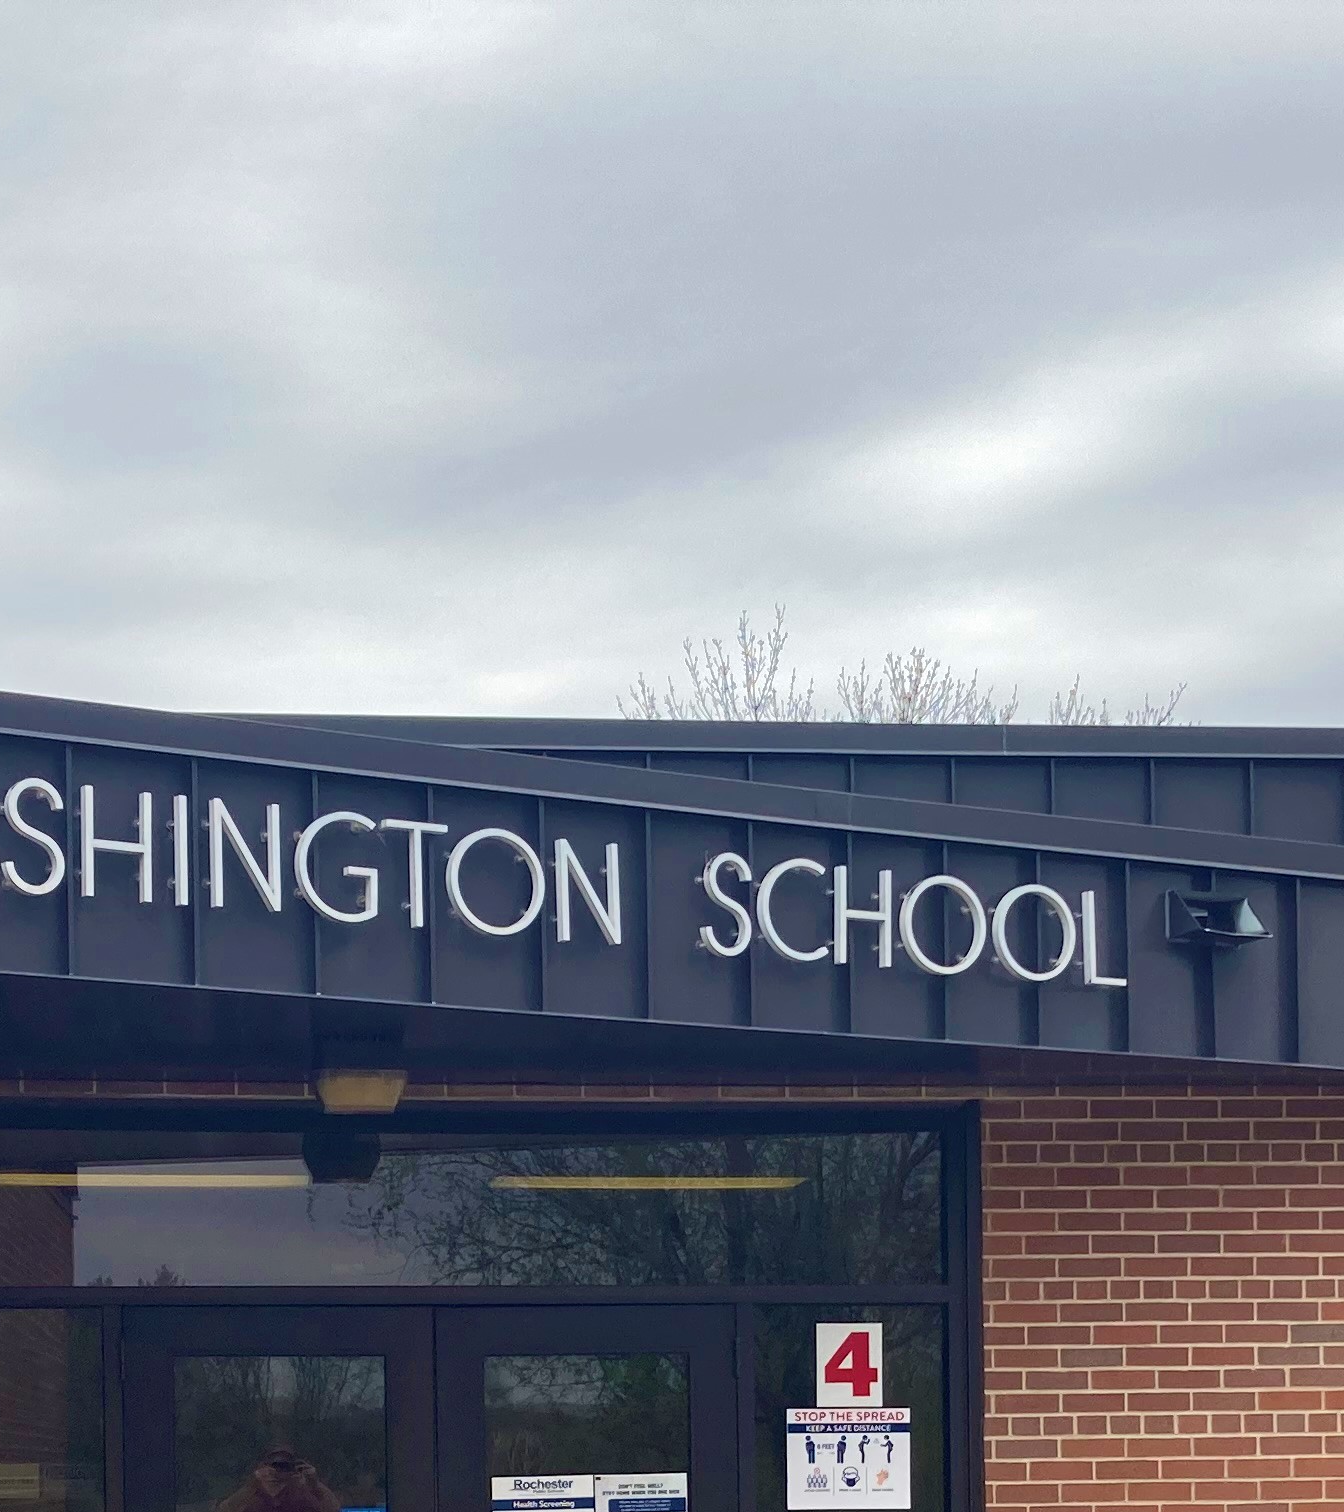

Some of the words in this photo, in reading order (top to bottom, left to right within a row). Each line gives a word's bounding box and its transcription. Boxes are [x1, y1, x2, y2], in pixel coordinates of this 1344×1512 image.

[699, 849, 1129, 991] SCHOOL
[824, 1331, 878, 1397] 4
[794, 1412, 826, 1421] STOP
[829, 1412, 853, 1421] THE
[856, 1411, 904, 1421] SPREAD
[854, 1424, 891, 1432] DISTANCE
[513, 1479, 574, 1490] Rochester
[513, 1500, 538, 1508] Health
[539, 1500, 575, 1508] Screening
